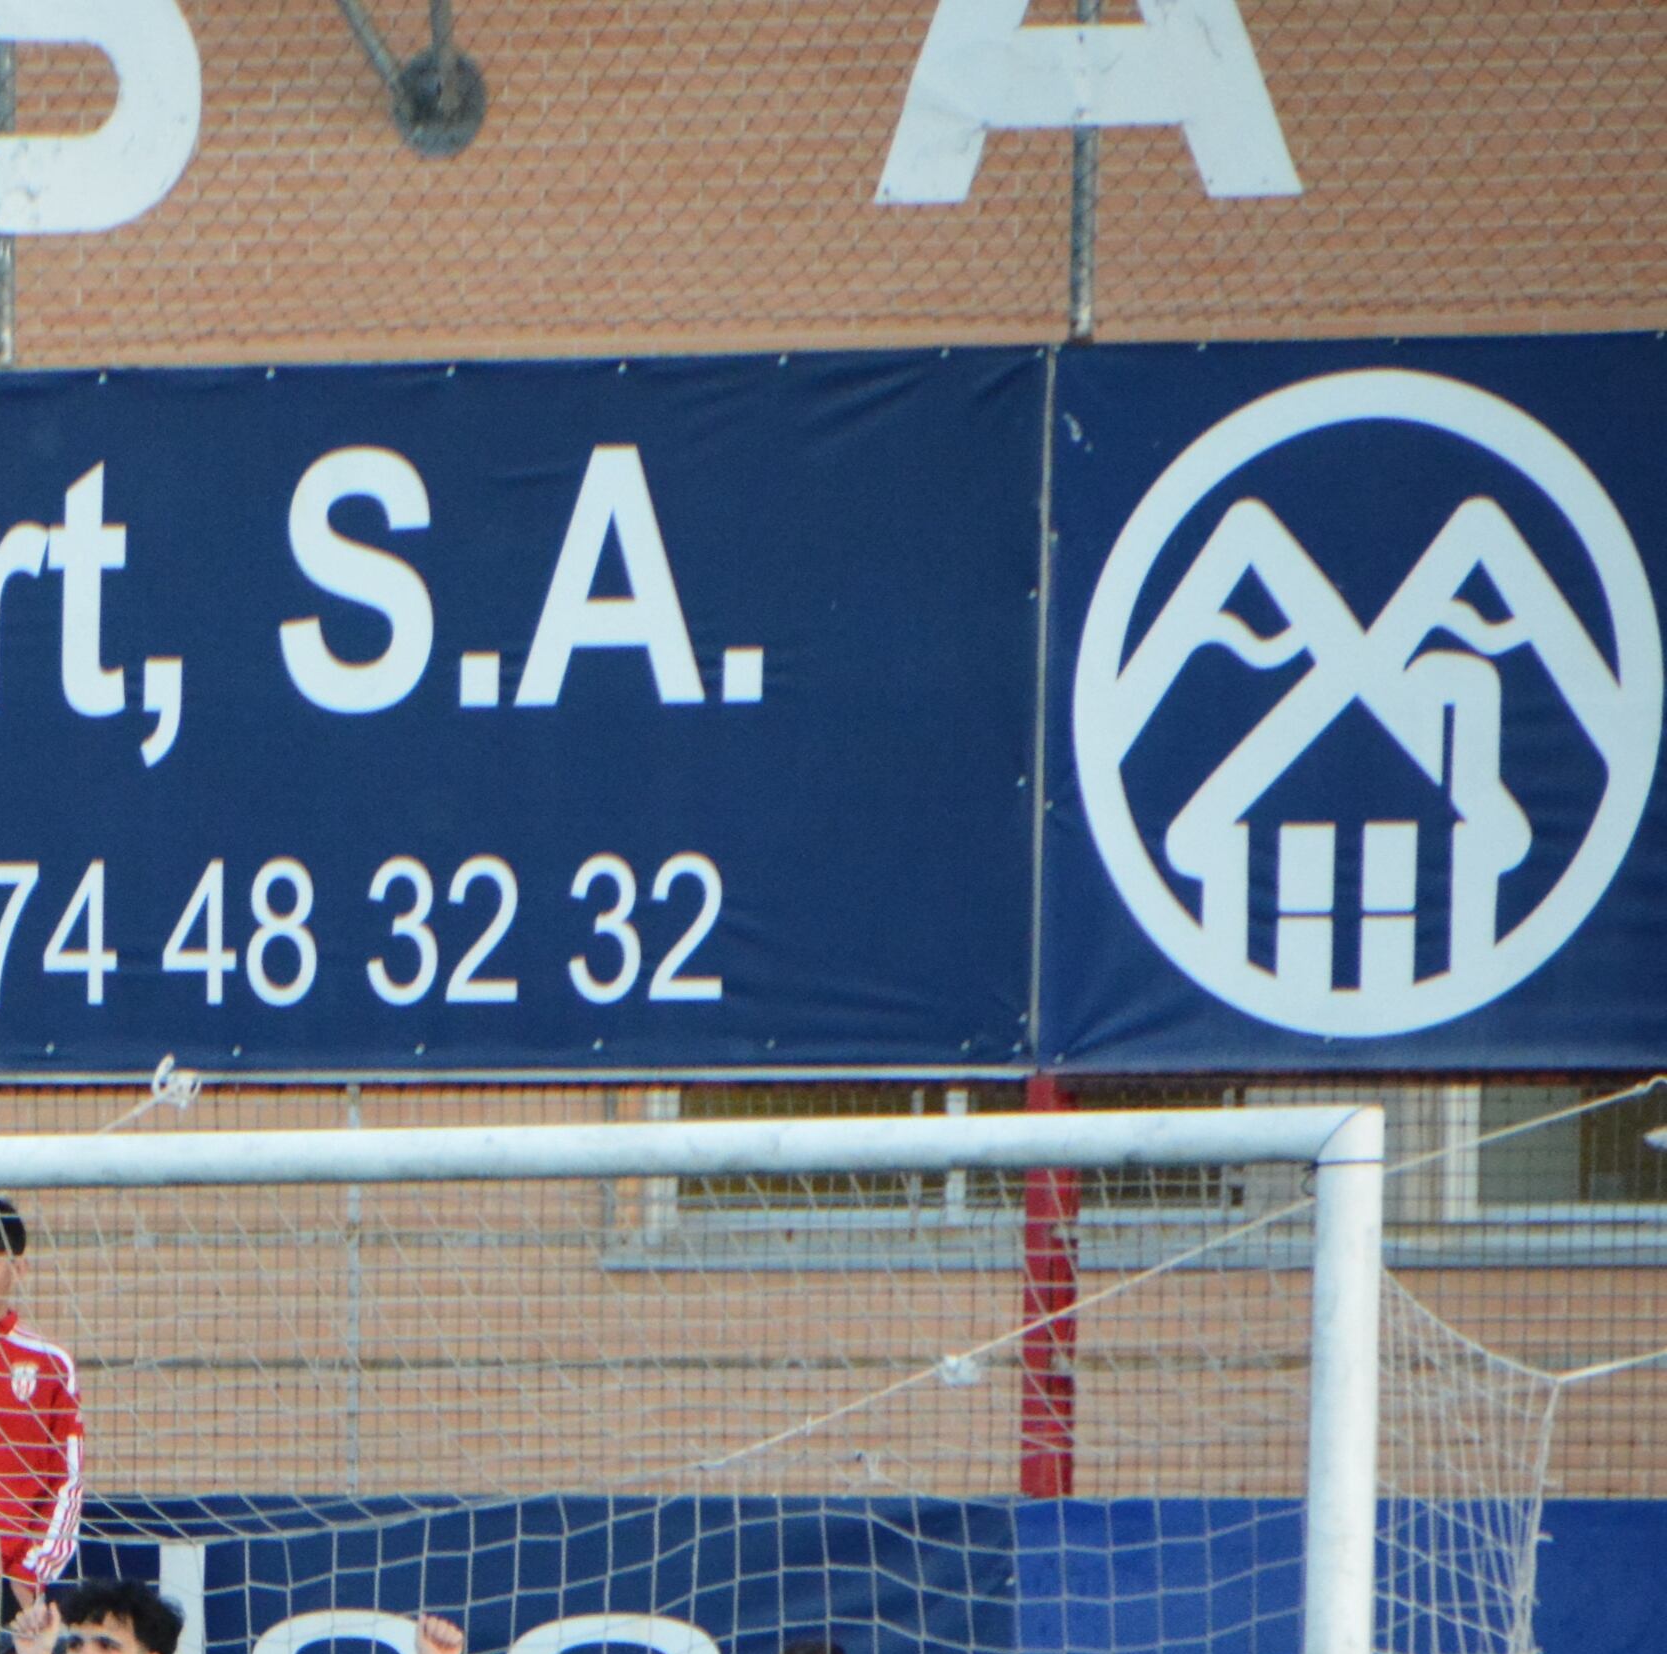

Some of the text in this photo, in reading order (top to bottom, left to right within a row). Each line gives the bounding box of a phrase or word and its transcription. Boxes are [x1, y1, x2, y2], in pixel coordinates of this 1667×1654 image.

[278, 443, 765, 713] S.A.
[161, 856, 318, 1006] 48
[366, 854, 519, 1005] 32
[568, 851, 723, 1003] 32
